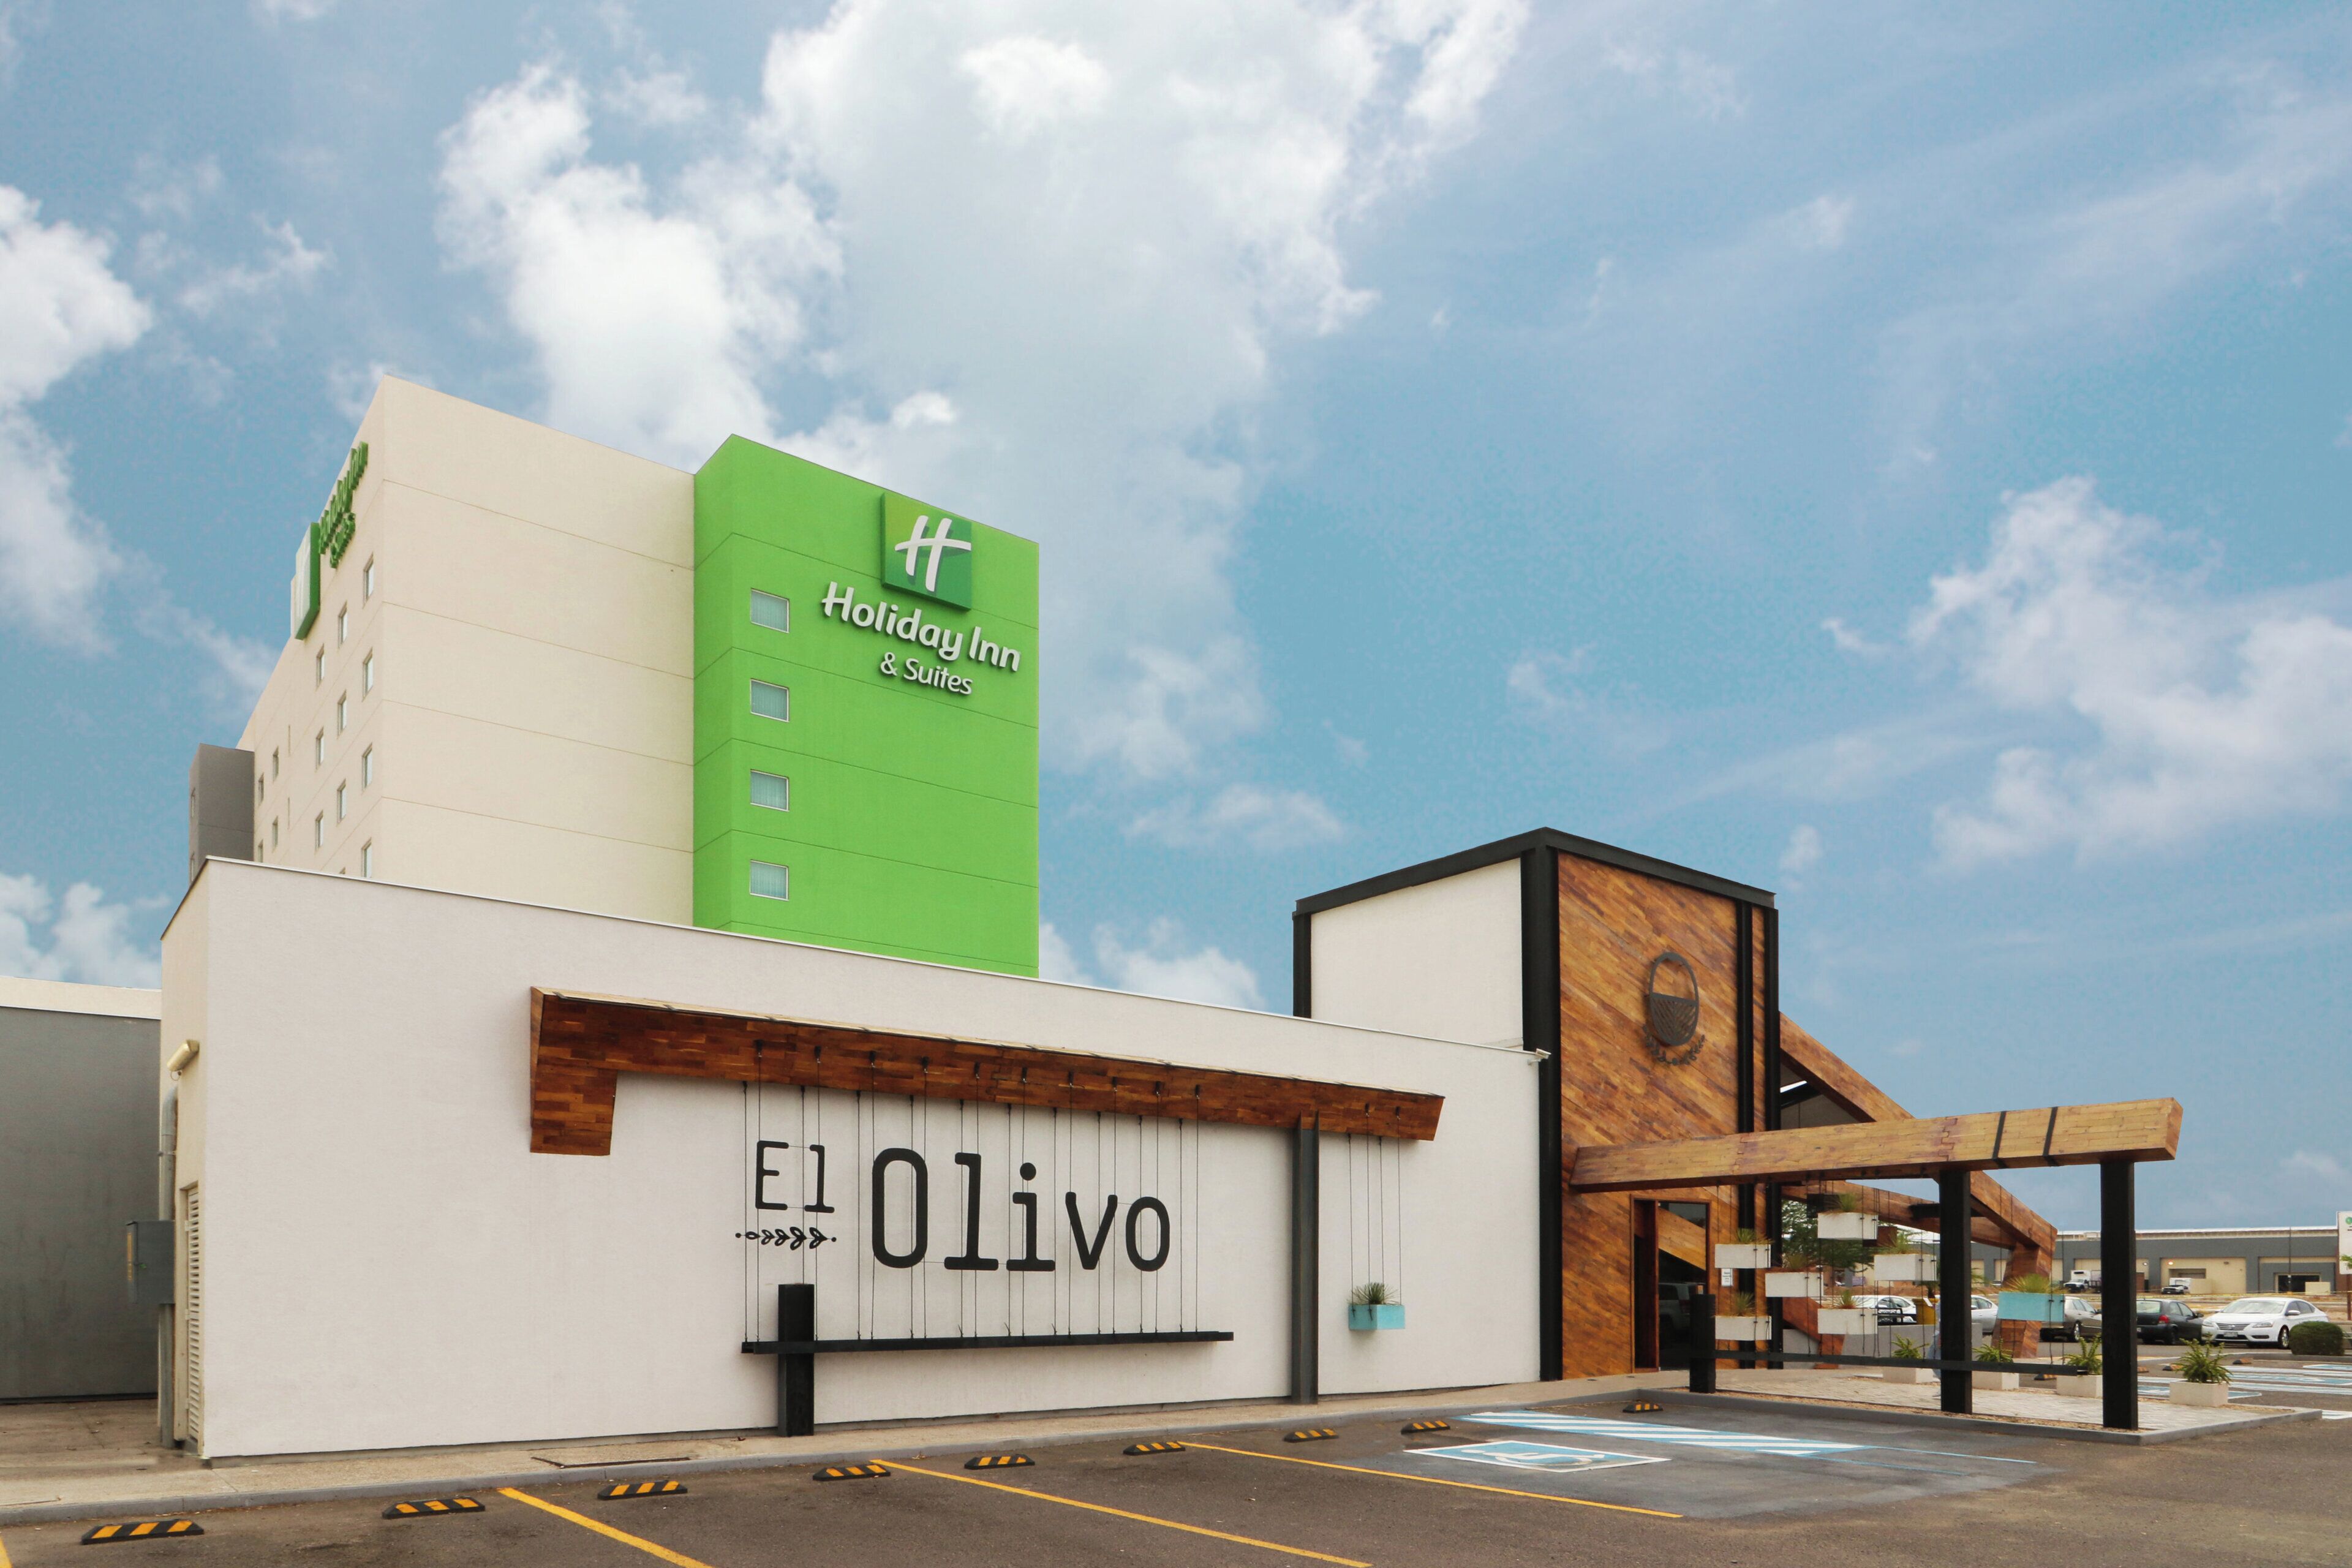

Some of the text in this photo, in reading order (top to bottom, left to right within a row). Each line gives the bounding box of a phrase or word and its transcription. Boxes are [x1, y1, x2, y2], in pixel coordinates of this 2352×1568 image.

[821, 581, 1021, 672] Holiday Inn
[880, 651, 973, 695] & Suites
[755, 1140, 1171, 1272] El Olivo
